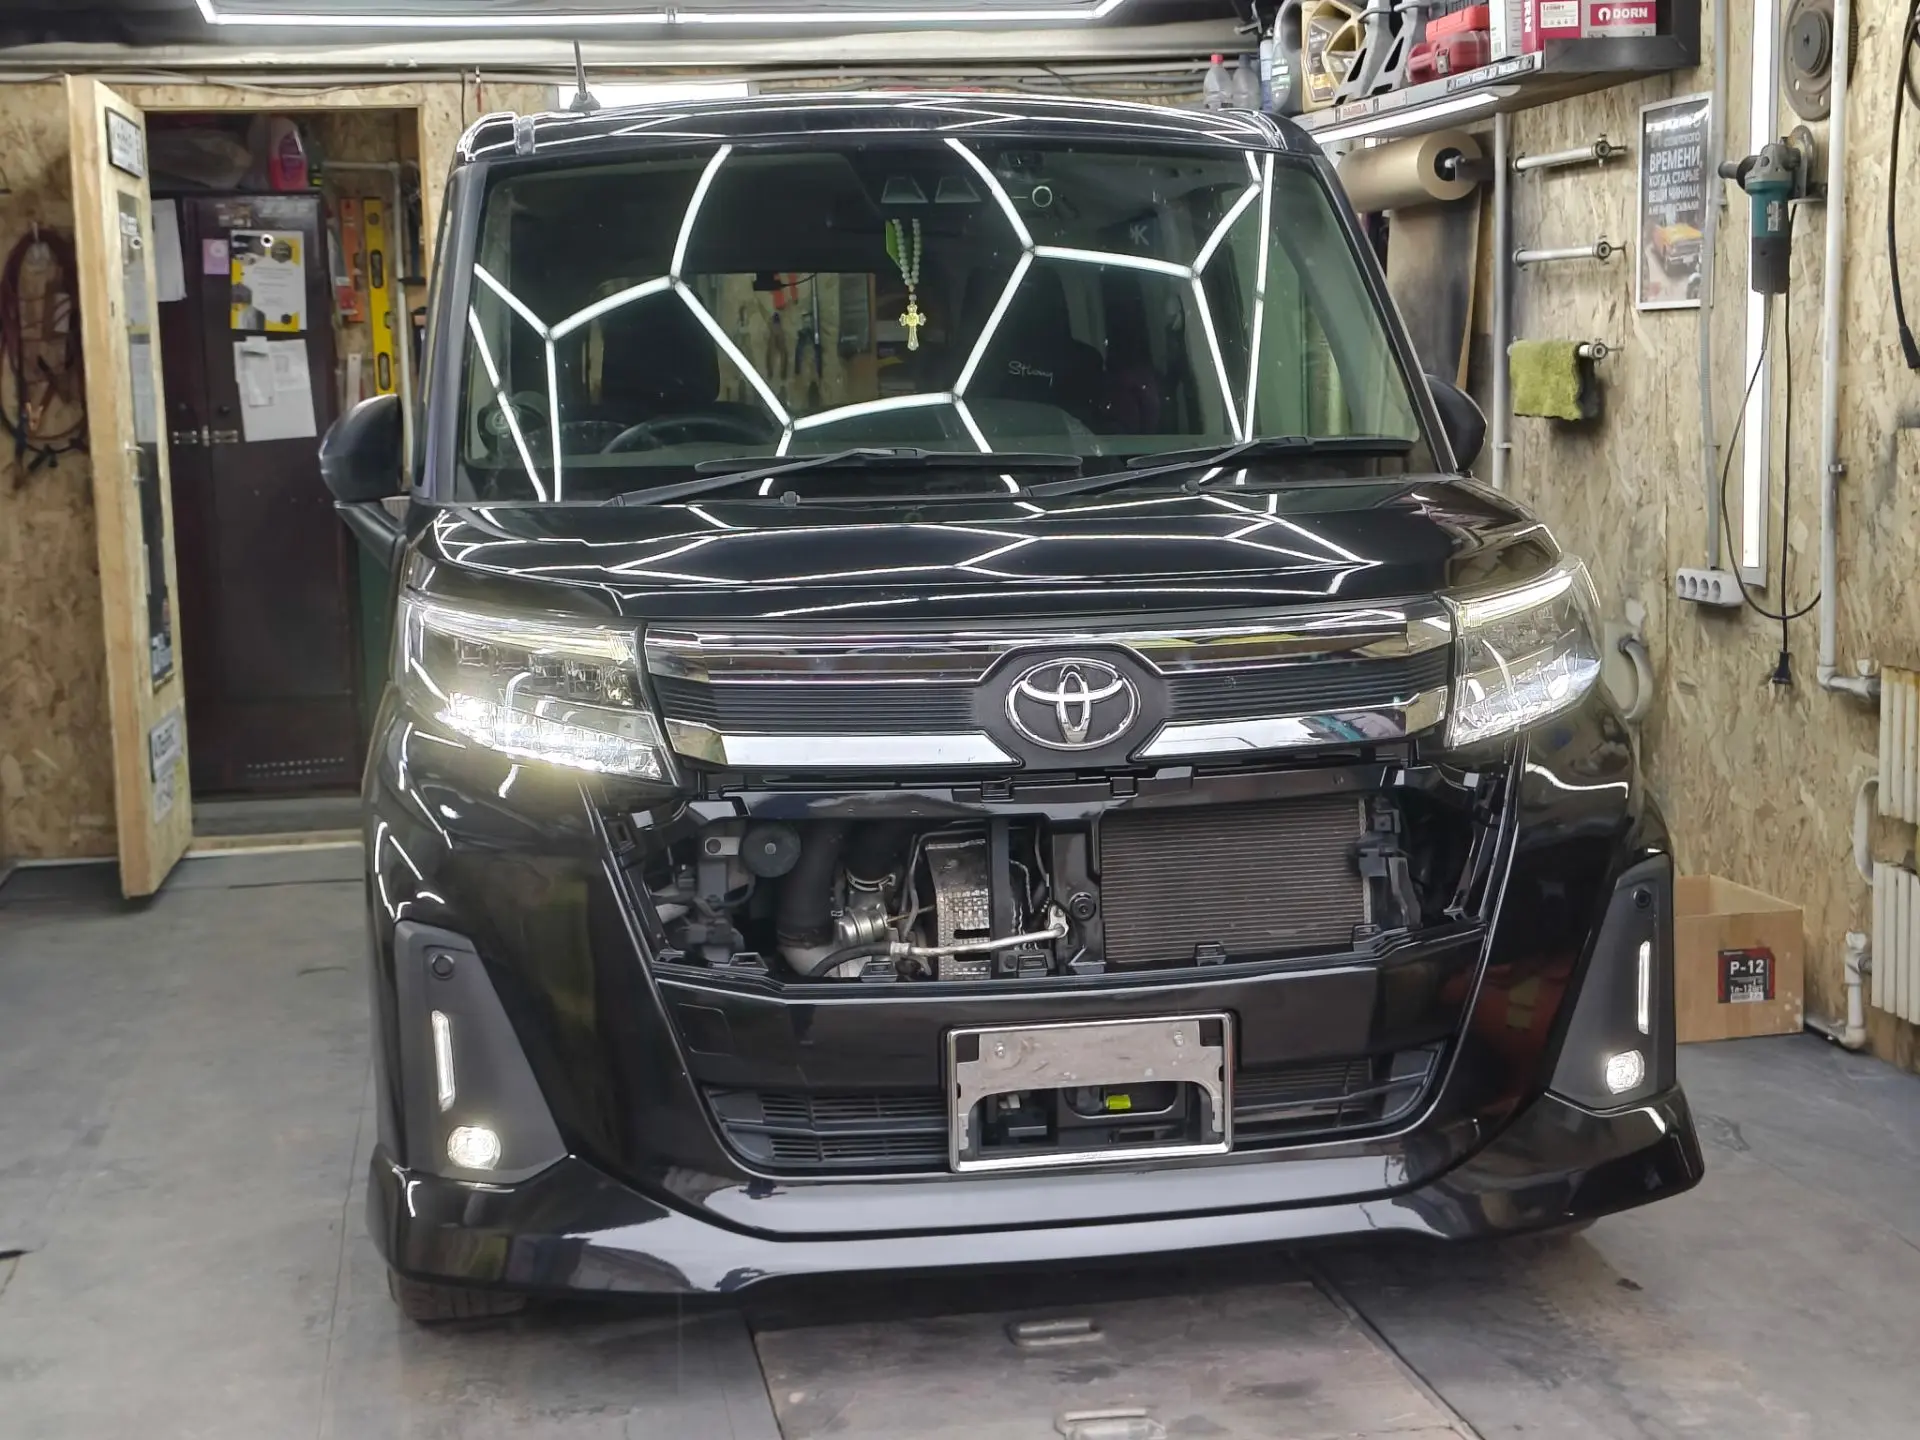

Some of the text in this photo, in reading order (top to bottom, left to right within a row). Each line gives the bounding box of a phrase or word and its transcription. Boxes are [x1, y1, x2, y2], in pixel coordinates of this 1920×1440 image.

[1612, 7, 1649, 19] DORN
[1650, 146, 1703, 173] ВРЕМЕНИ,
[1730, 959, 1764, 975] P-12
